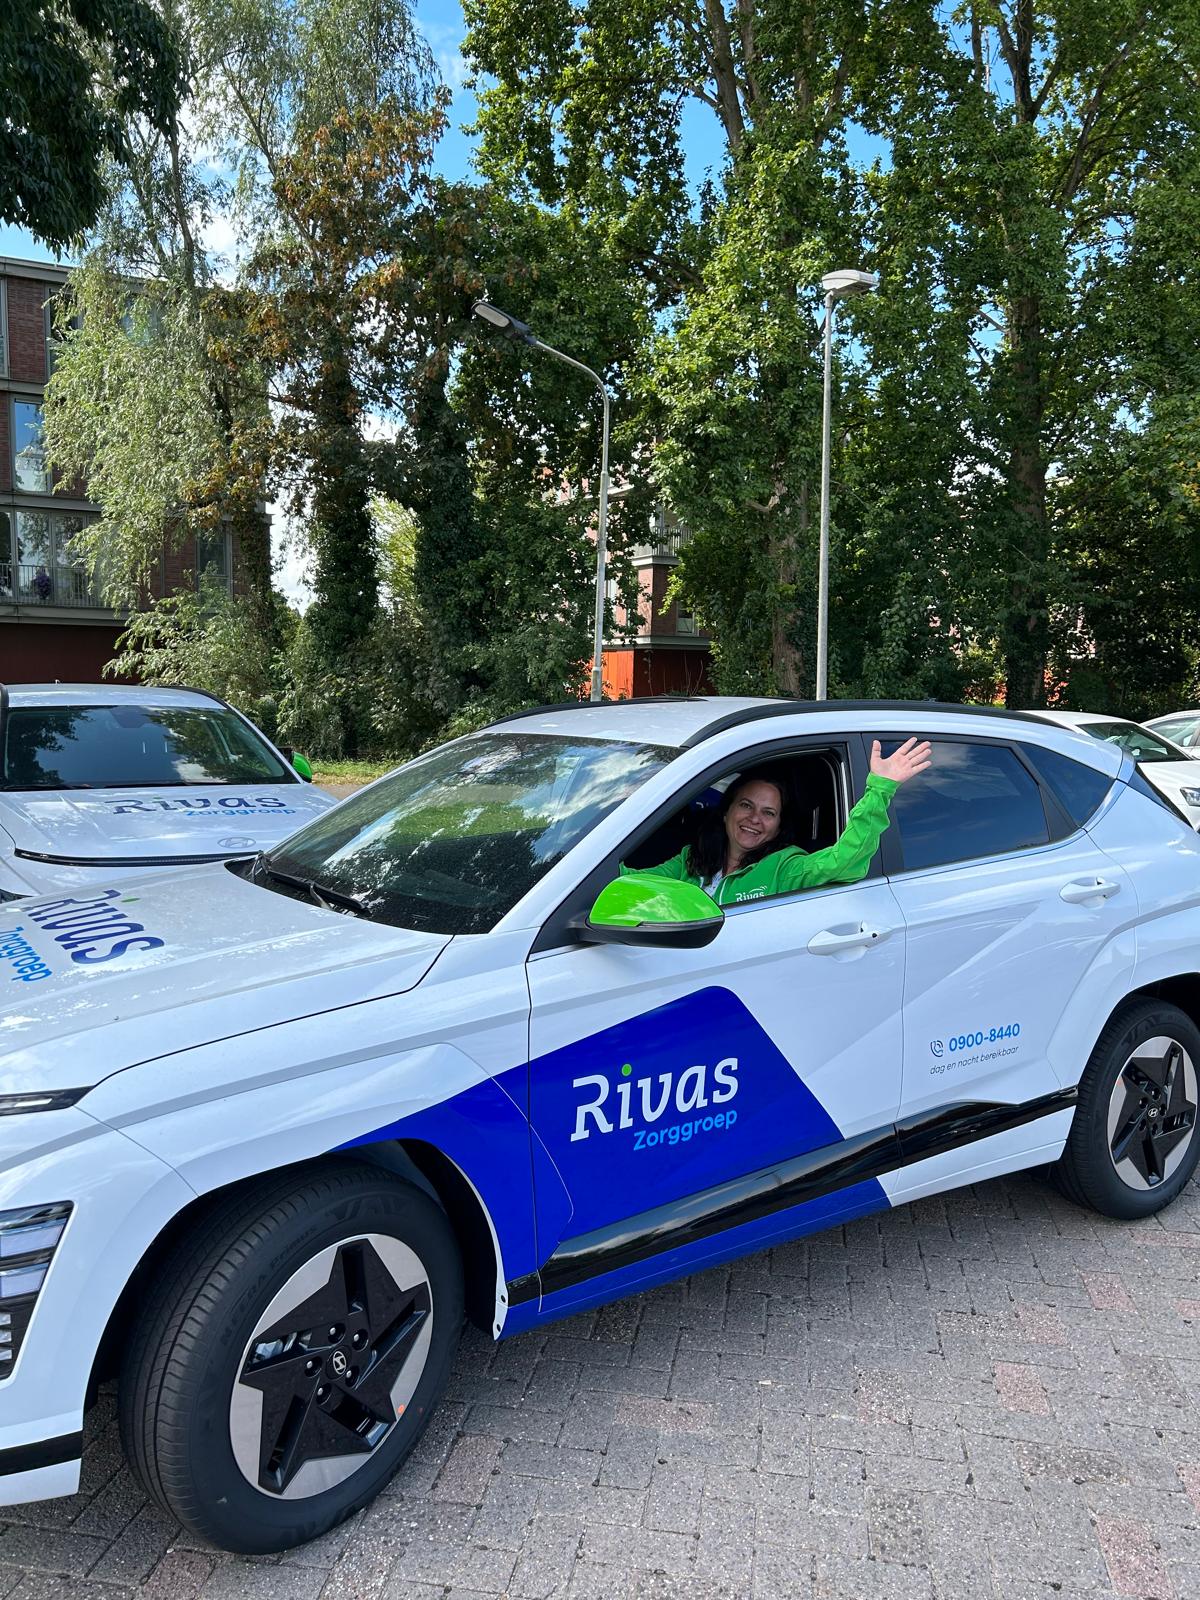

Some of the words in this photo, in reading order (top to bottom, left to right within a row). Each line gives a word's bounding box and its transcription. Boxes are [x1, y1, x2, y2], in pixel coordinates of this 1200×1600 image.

[104, 796, 287, 815] Rivas
[186, 807, 297, 817] Zorggroep
[22, 889, 165, 965] Rivas
[949, 1023, 1020, 1052] 0900-8440
[930, 1065, 946, 1075] dag
[946, 1061, 957, 1071] en
[957, 1055, 980, 1067] nacht
[980, 1046, 1020, 1062] bereikbaar
[570, 1057, 739, 1142] Rivas
[633, 1109, 738, 1151] Zorggroep
